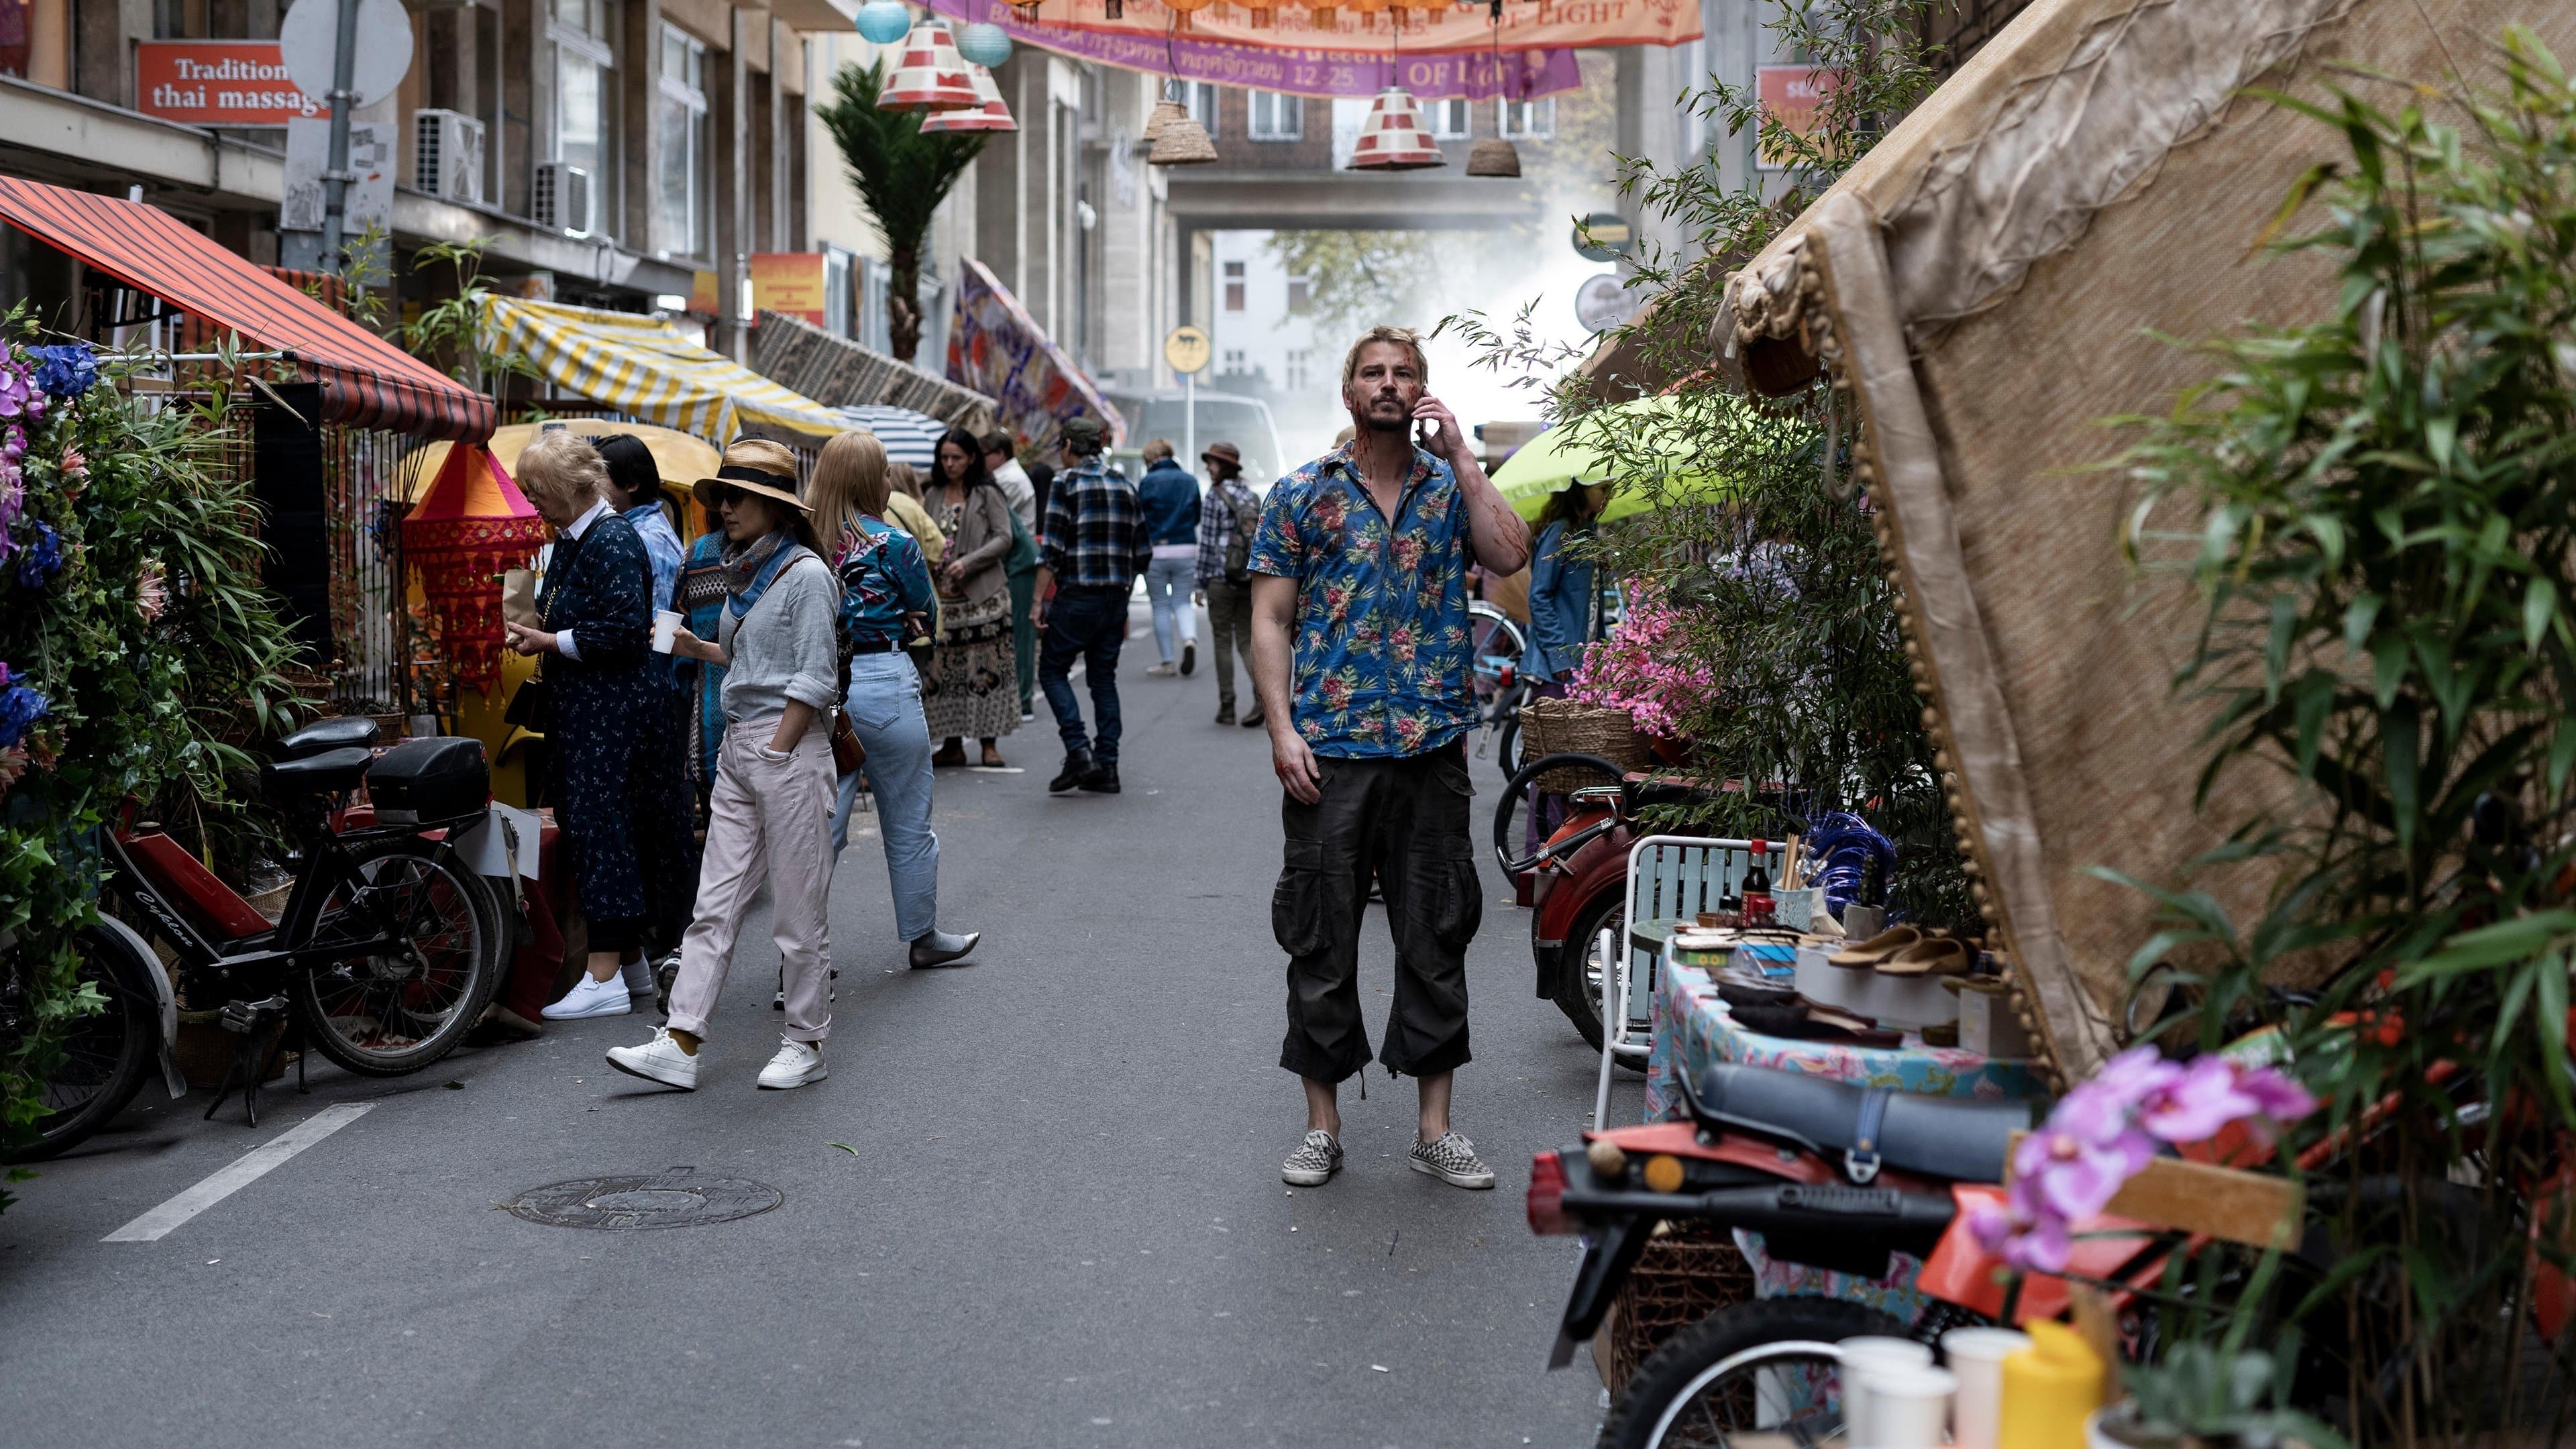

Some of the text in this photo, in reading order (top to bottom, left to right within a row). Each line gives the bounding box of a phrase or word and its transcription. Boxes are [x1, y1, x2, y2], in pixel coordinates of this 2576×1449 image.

[1538, 1, 1630, 25] LIGHT
[174, 58, 290, 80] Tradition
[1409, 62, 1450, 87] OF
[152, 83, 206, 108] thai
